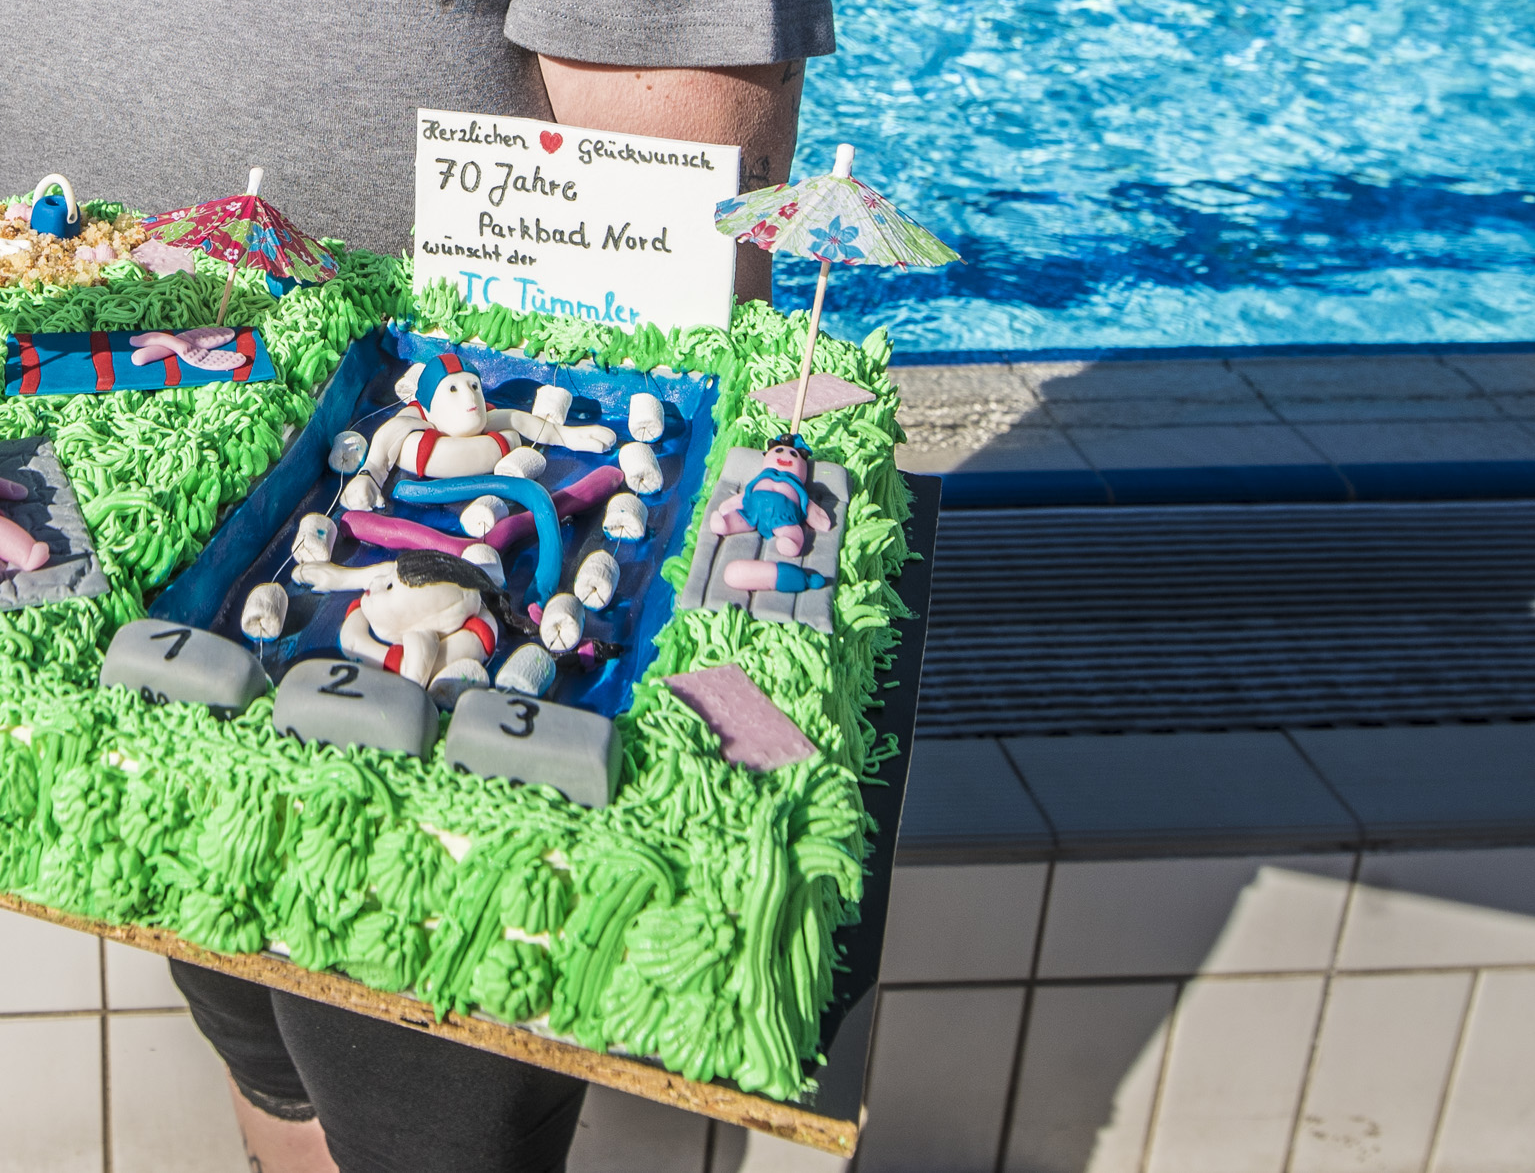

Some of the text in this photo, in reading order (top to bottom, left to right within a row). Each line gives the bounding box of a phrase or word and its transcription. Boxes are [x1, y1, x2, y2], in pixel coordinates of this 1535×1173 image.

[421, 119, 714, 171] Herzlichen Glückwunsch
[435, 157, 578, 207] 70 Jahre
[421, 235, 538, 266] wünscht der
[478, 210, 672, 254] Parkbad Nord
[459, 270, 641, 325] TC Tümmler
[150, 628, 192, 660] 1
[318, 663, 364, 698] 2
[499, 697, 541, 738] 3
